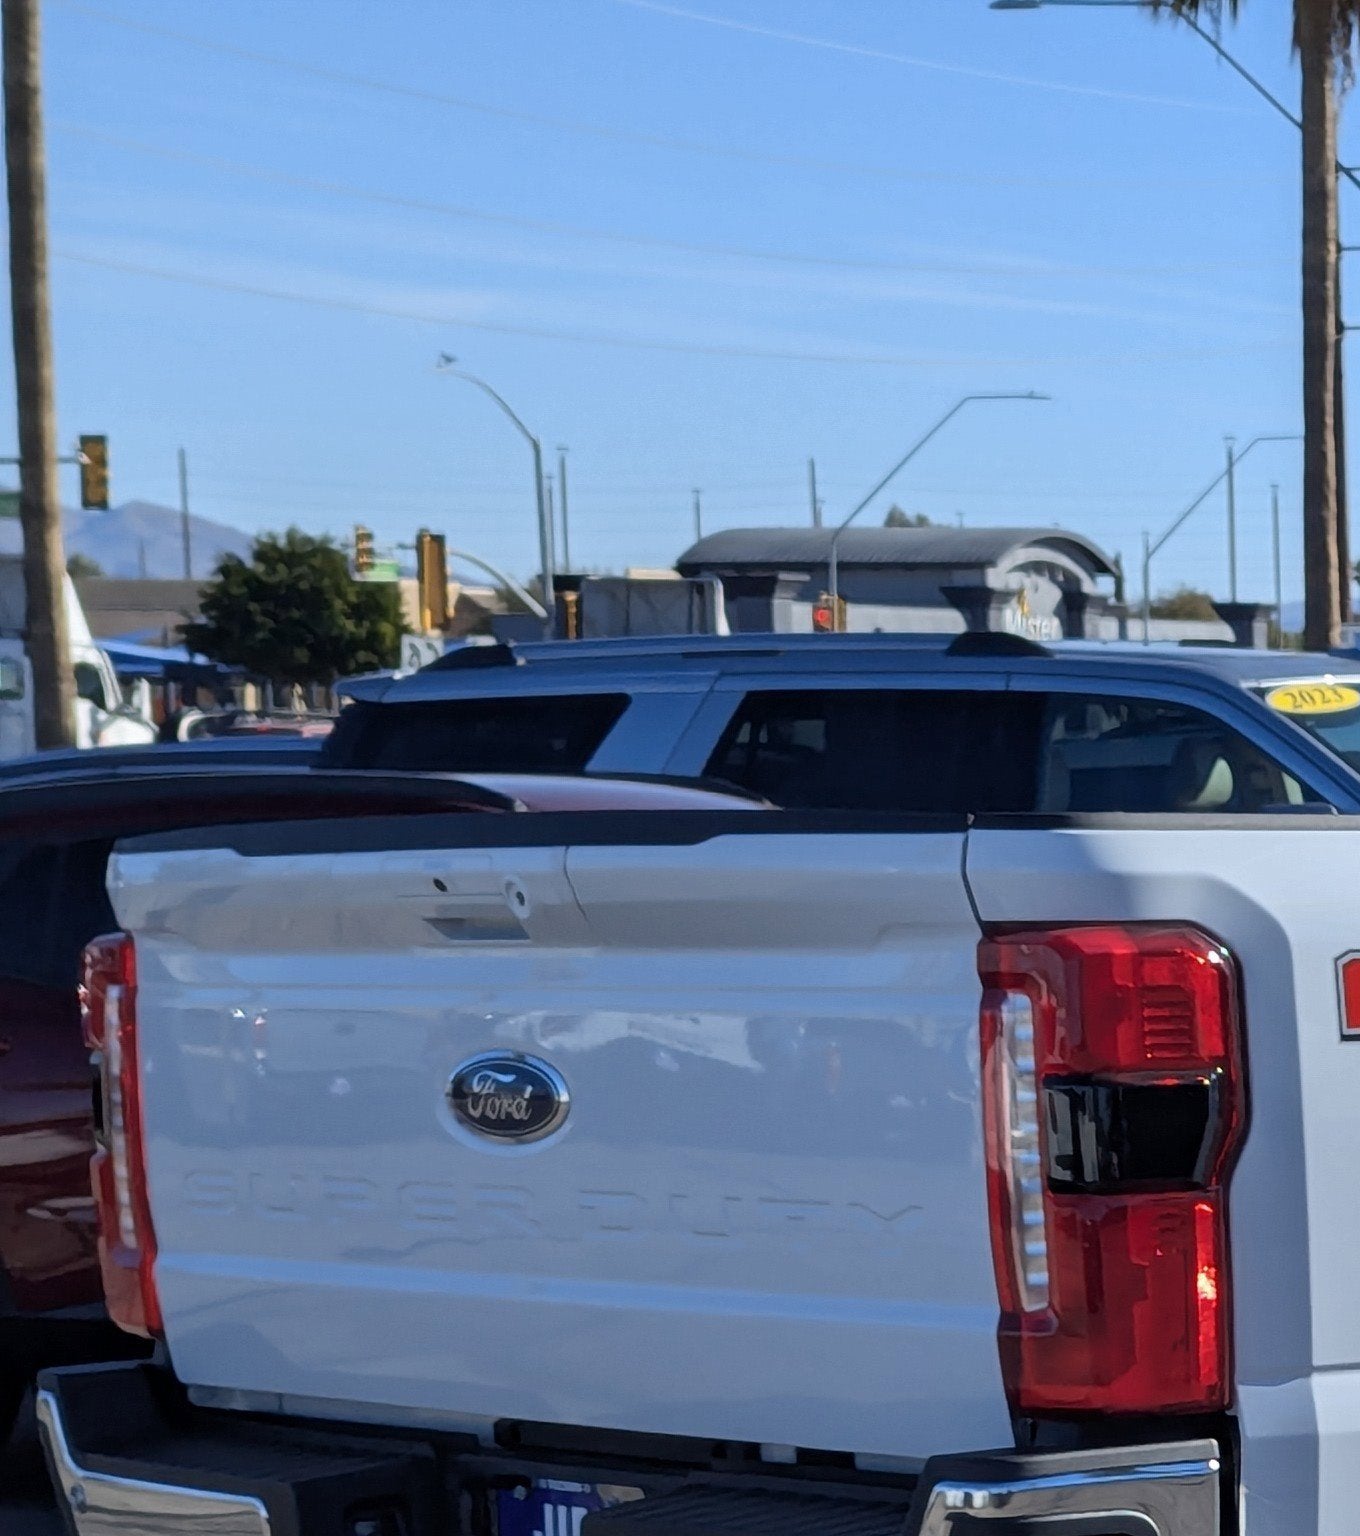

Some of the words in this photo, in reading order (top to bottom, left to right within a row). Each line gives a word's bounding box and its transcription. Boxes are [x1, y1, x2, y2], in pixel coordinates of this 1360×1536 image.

[1284, 685, 1343, 709] 2023
[466, 1069, 534, 1121] Ford
[183, 1170, 545, 1236] SUPER
[578, 1188, 926, 1246] DUTY
